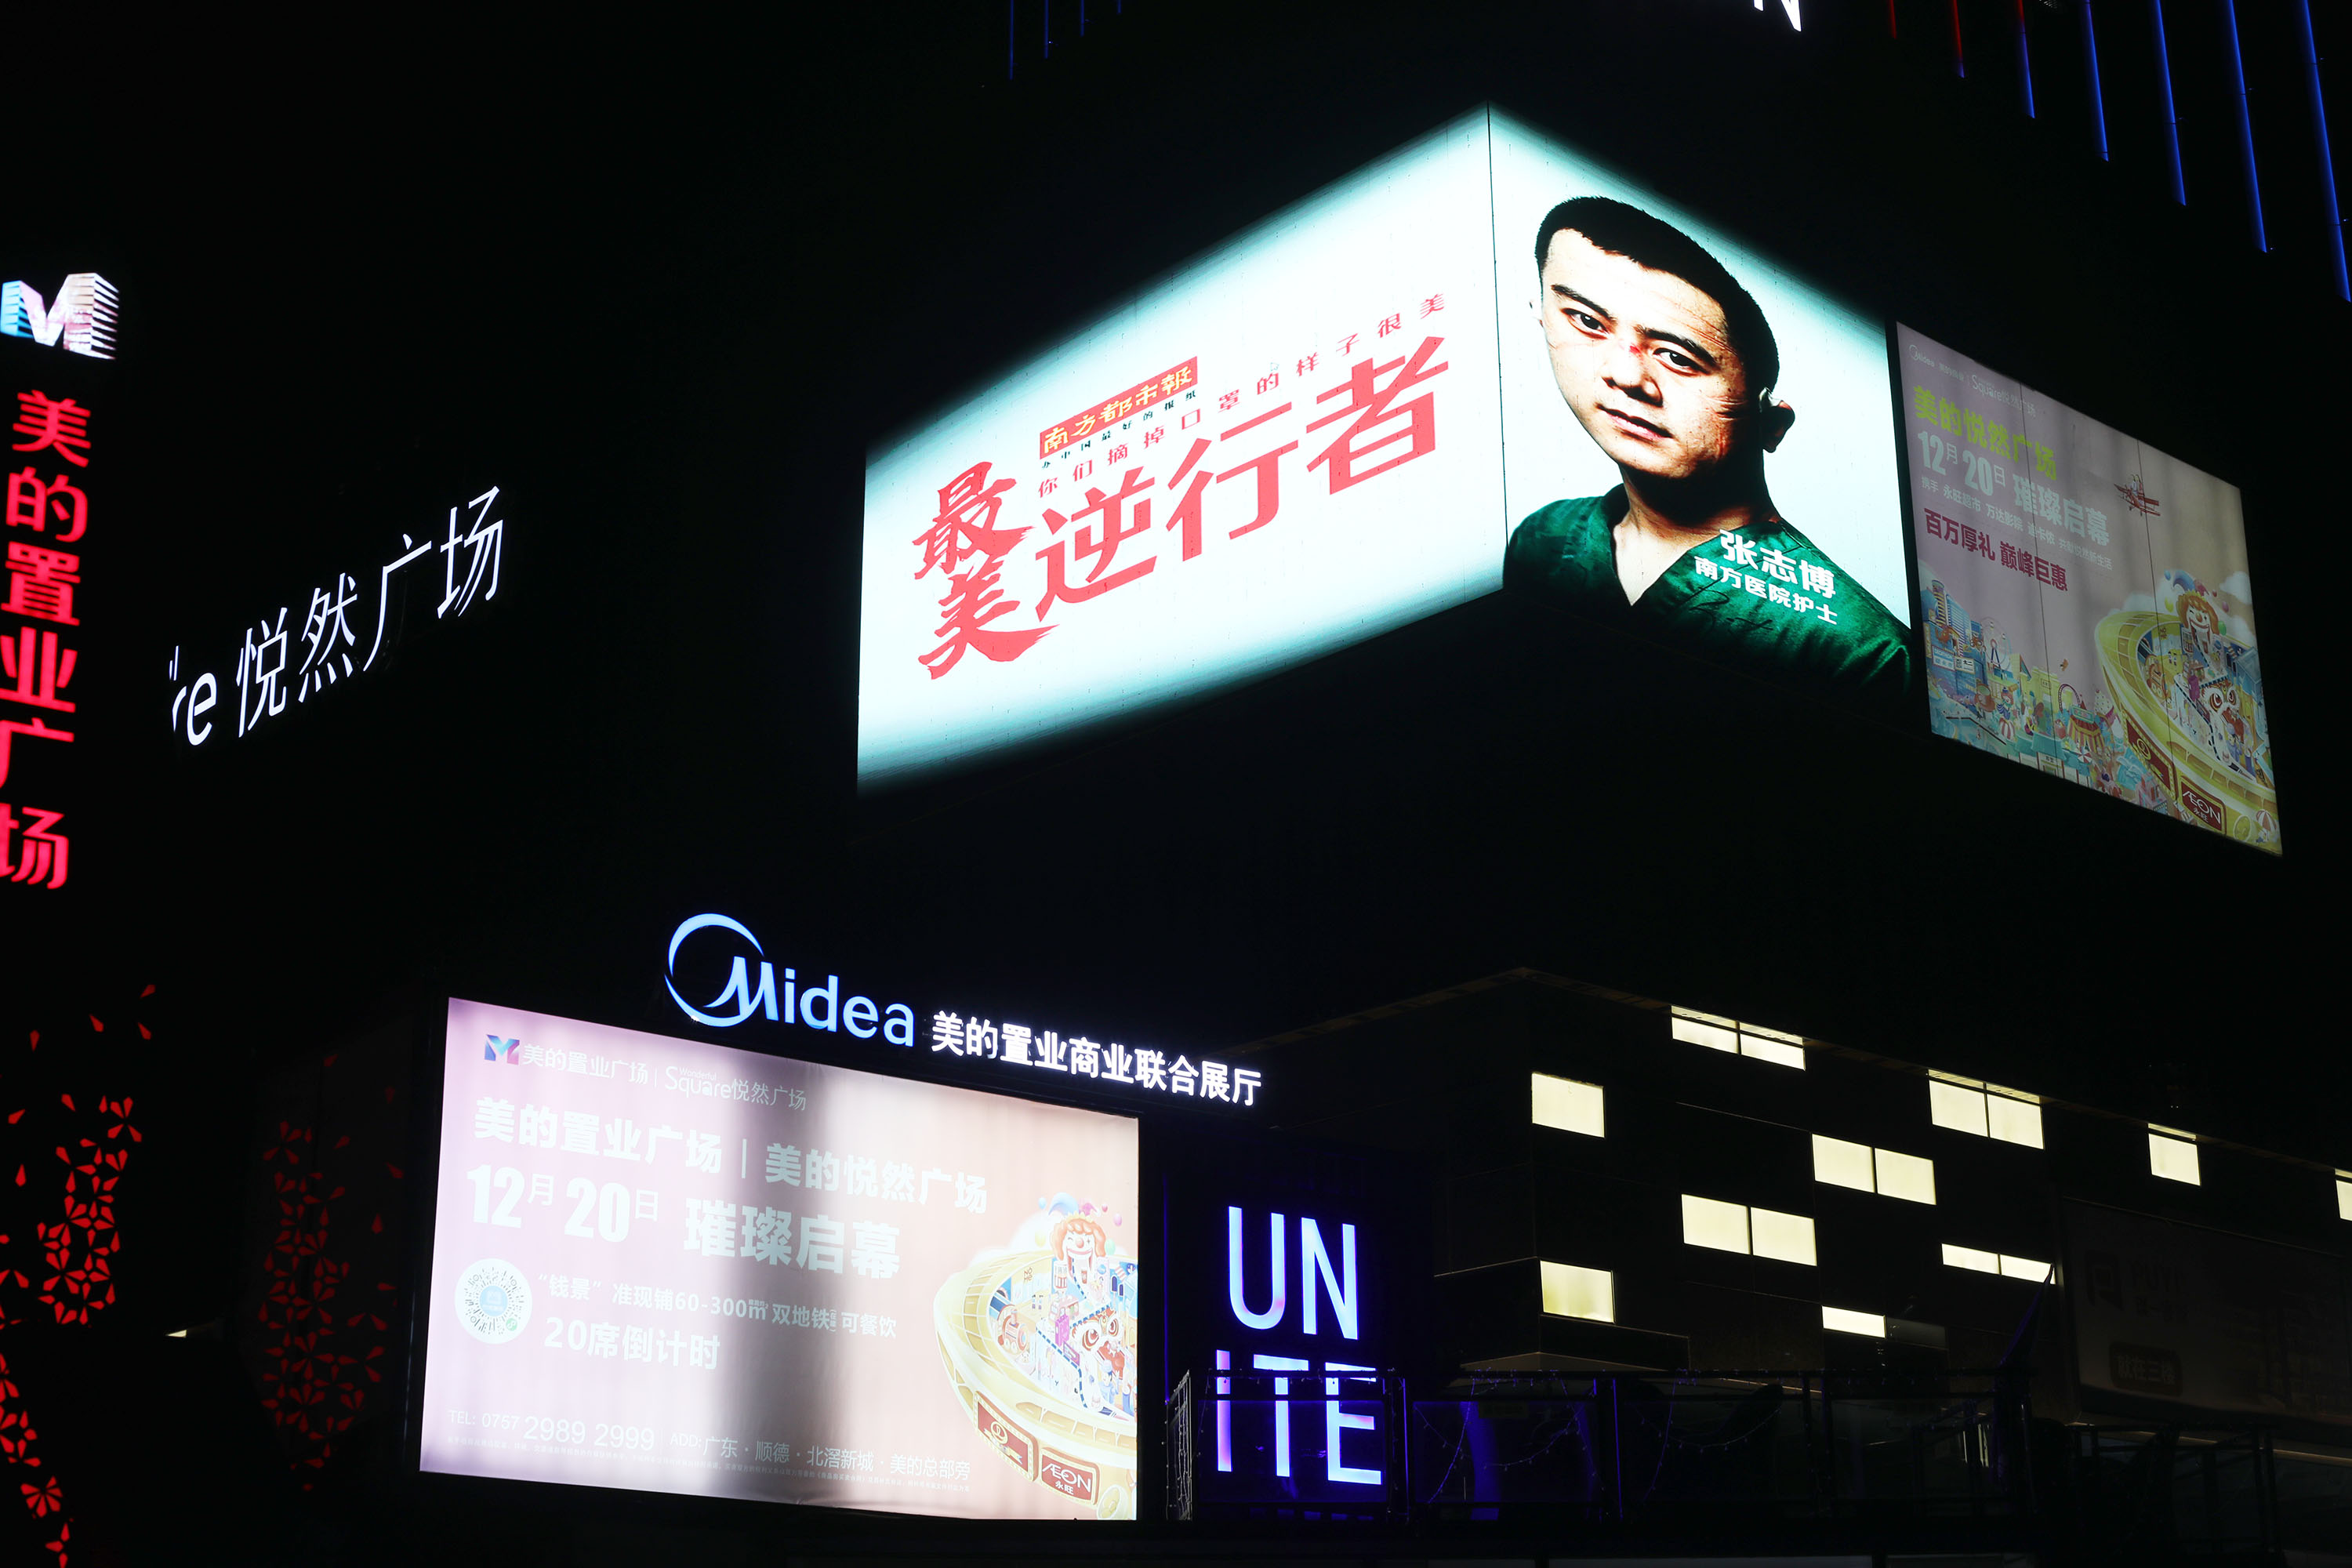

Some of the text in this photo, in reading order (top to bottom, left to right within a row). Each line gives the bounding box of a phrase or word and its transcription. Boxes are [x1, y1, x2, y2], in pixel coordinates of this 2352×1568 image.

[1038, 293, 1445, 499] 你们摘掉口罩的样子很美
[1914, 385, 2057, 481] 美的悦然广场
[1035, 336, 1449, 622] 逆行者
[1943, 484, 1981, 512] 永旺超市
[1986, 503, 2024, 532] 万达影院
[1694, 555, 1838, 625] 南方医院护士
[1719, 529, 1837, 599] 张志博
[1924, 508, 2068, 592] 百万厚礼 巅峰巨惠
[0, 390, 92, 890] 美的置业广场
[236, 485, 504, 739] 悦然广场
[664, 913, 1263, 1107] Midea 美的置业商业联合展厅
[523, 1044, 648, 1086] 美的置业广场
[474, 1097, 988, 1214] 美的置业广场 美的悦然广场
[684, 1198, 901, 1279] 璀璨启幕
[1228, 1205, 1359, 1340] UN
[842, 1312, 897, 1339] 可餐饮
[481, 1413, 520, 1431] 0757
[523, 1416, 586, 1446] 2989
[594, 1423, 655, 1452] 2999
[1216, 1349, 1381, 1485] ITE
